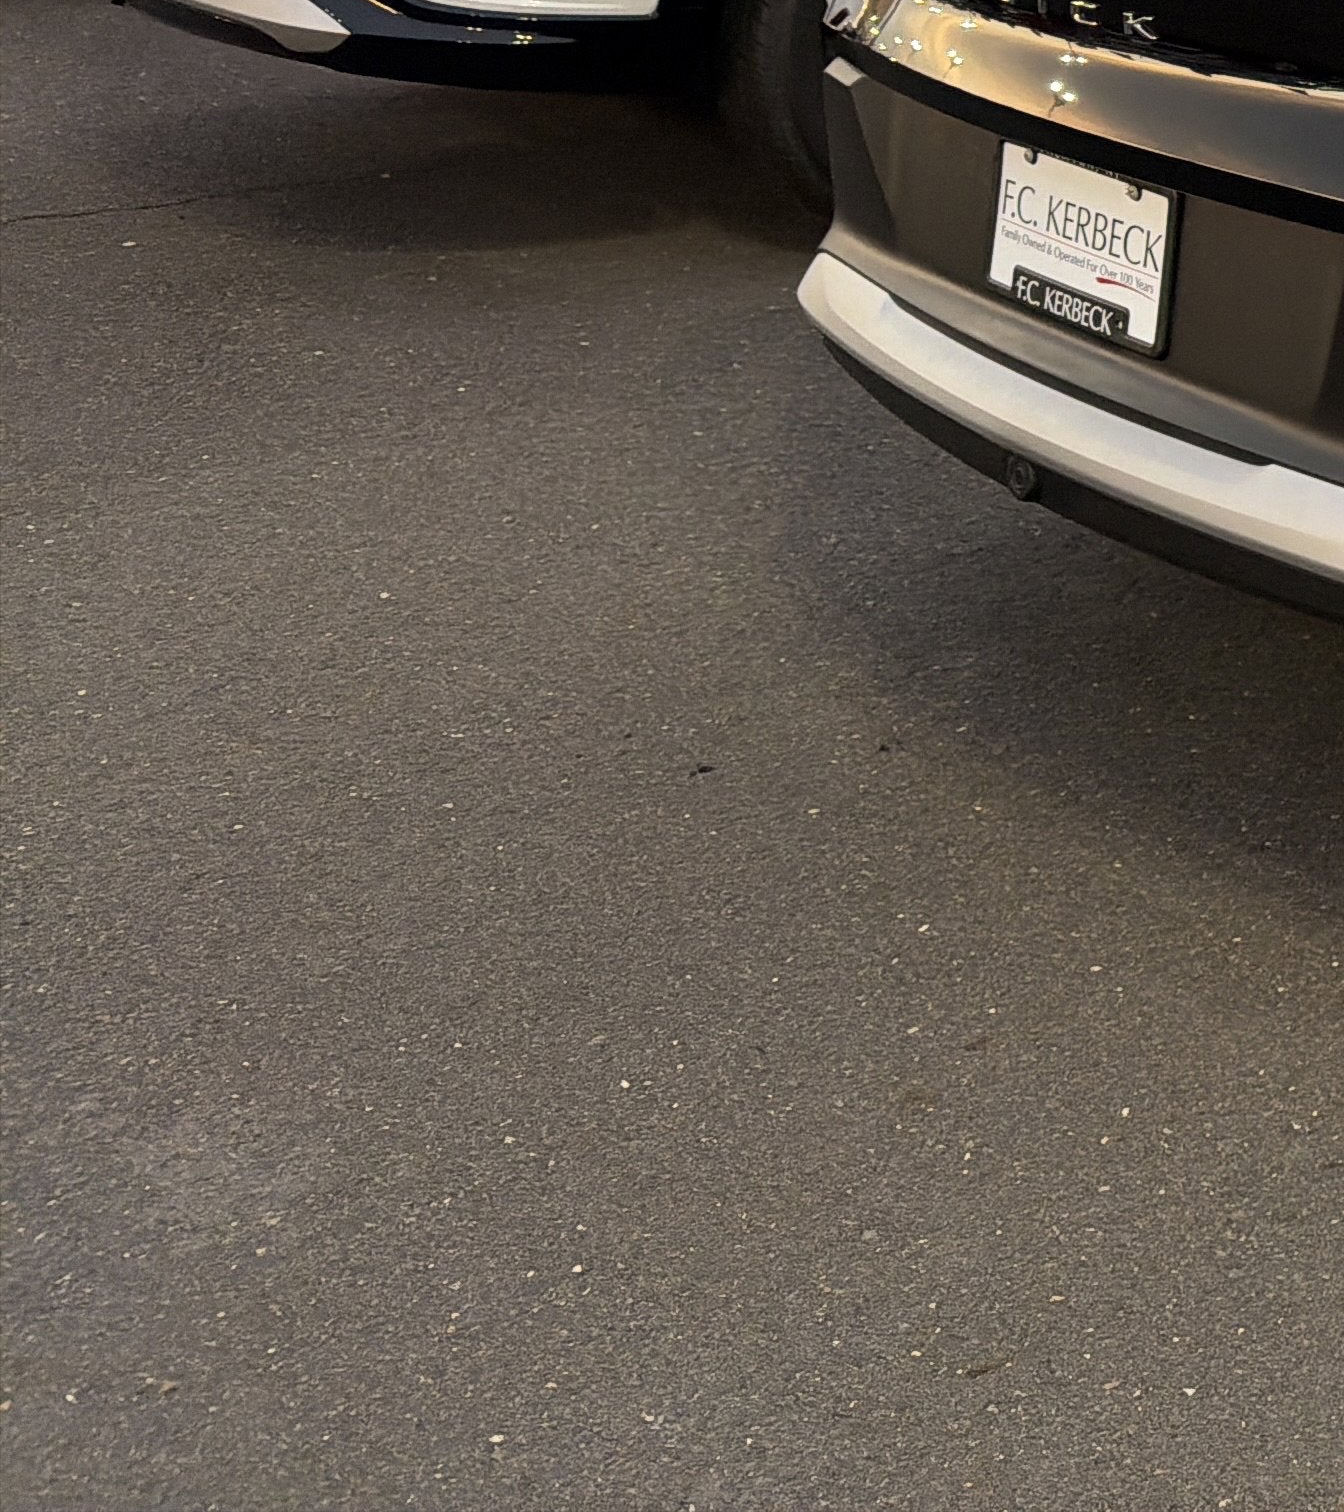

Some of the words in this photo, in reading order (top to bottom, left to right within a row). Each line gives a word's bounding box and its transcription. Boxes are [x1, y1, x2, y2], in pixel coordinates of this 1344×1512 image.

[1001, 179, 1038, 228] F.C.
[1046, 194, 1163, 273] KERBECK
[1001, 225, 1021, 245] Family
[1022, 234, 1046, 254] Owned
[1046, 245, 1053, 256] &
[1054, 247, 1085, 269] Operated
[1086, 259, 1099, 272] For
[1099, 264, 1118, 279] Over
[1119, 271, 1134, 286] 100
[1135, 276, 1155, 294] Years
[1016, 276, 1041, 307] F.C.
[1043, 287, 1114, 336] KERBECK
